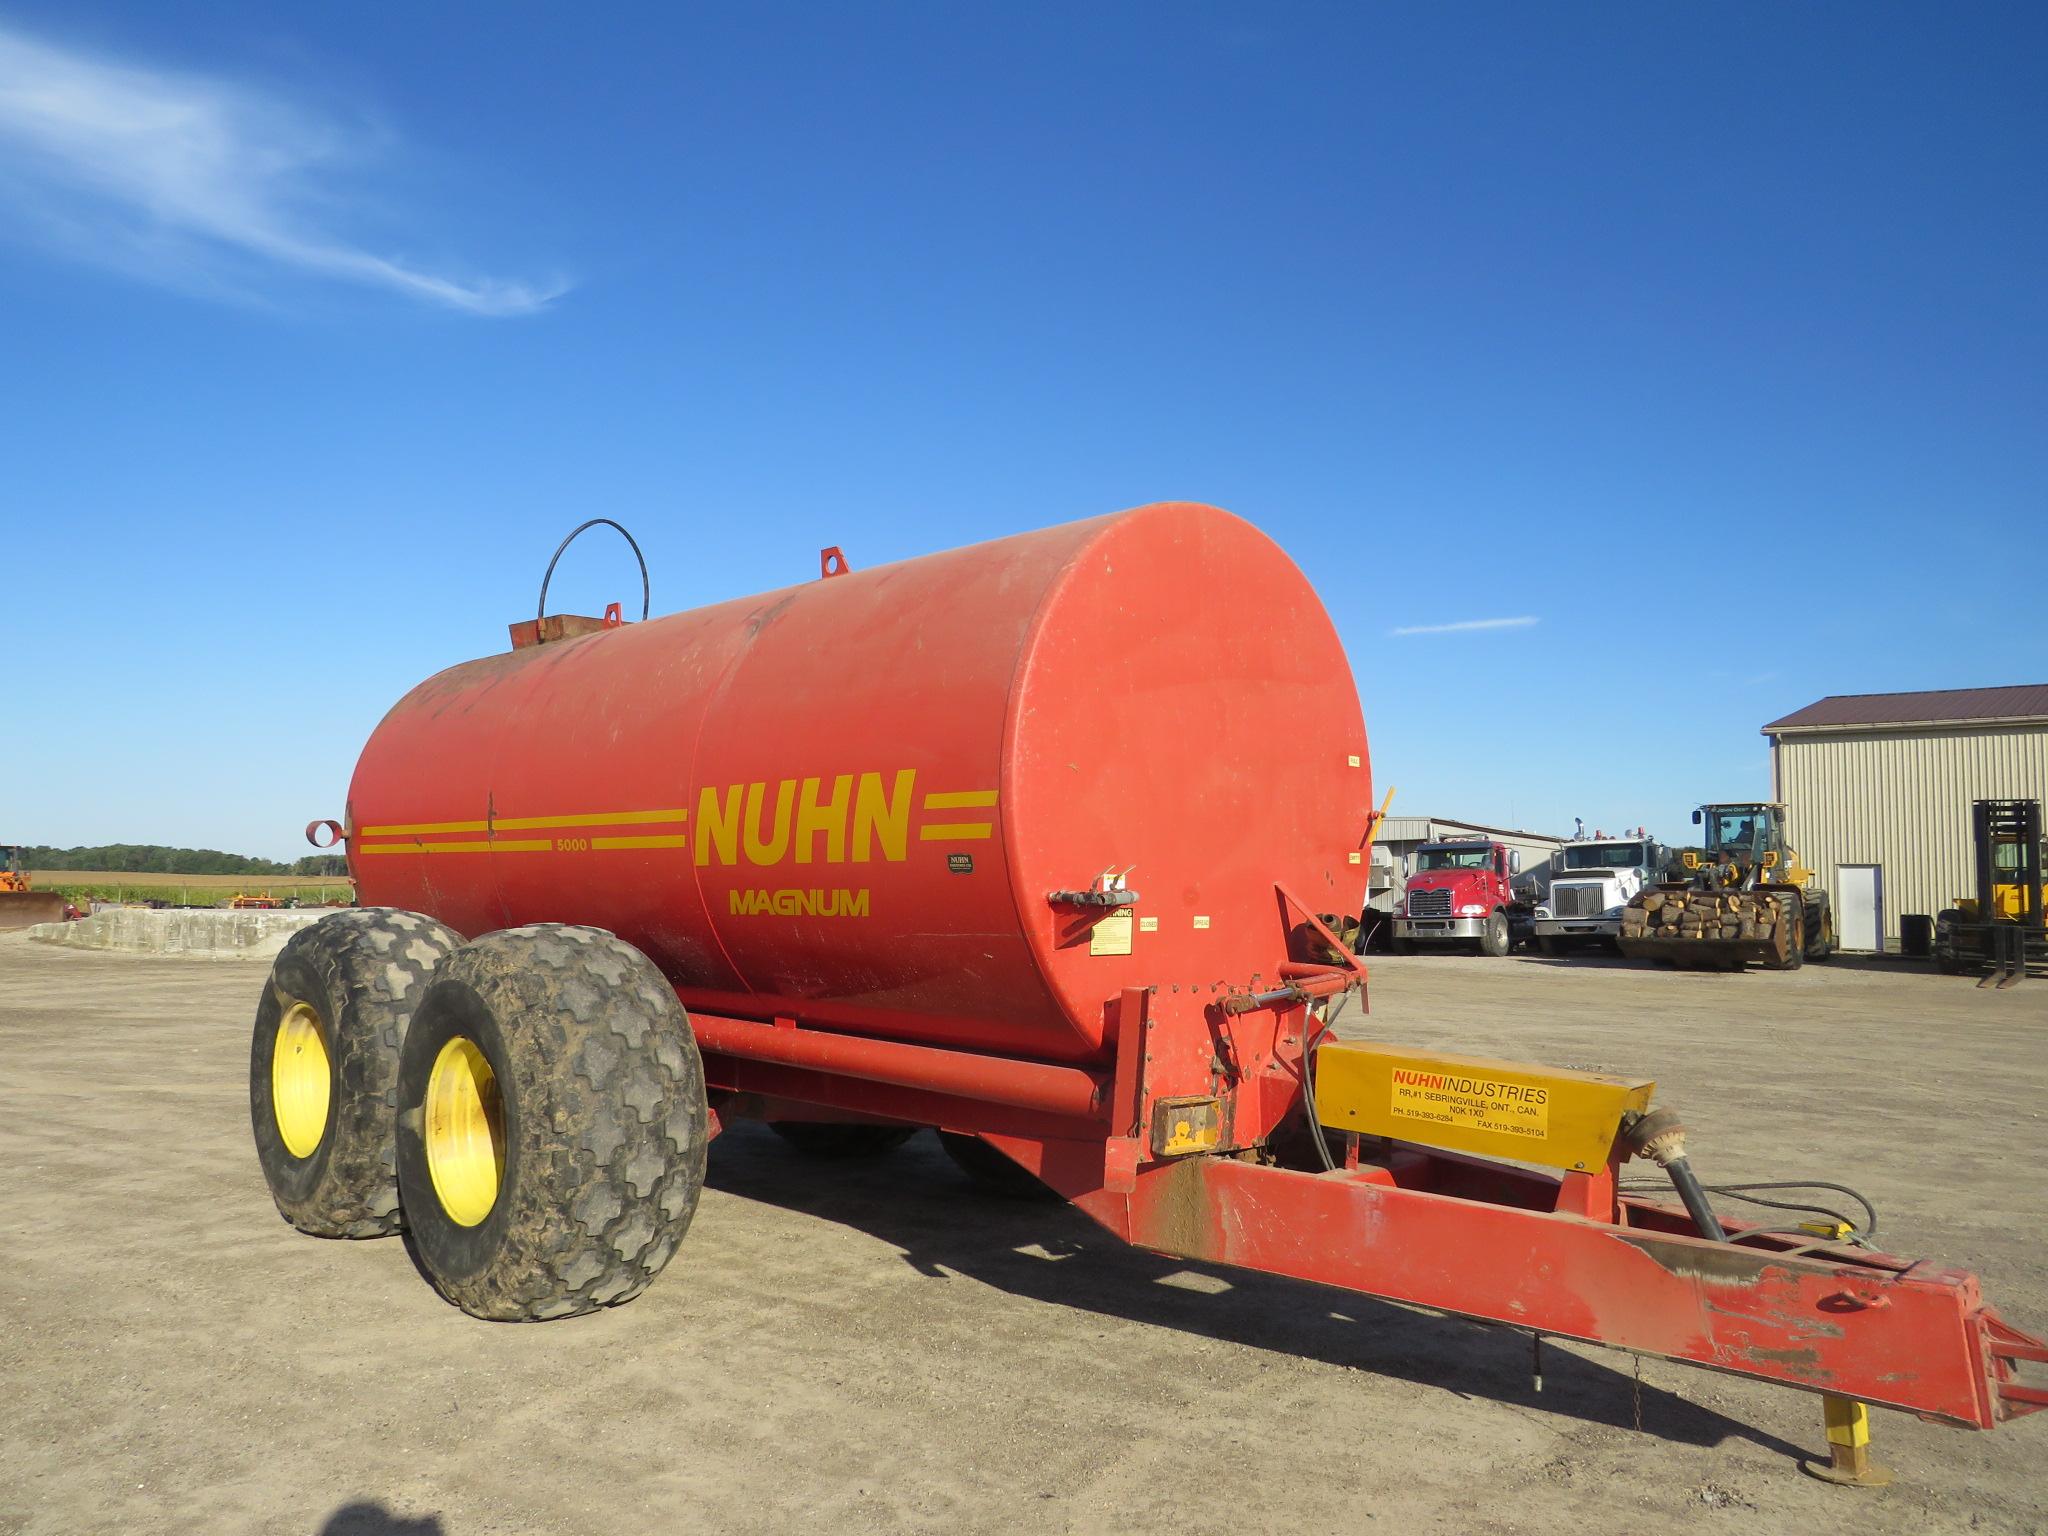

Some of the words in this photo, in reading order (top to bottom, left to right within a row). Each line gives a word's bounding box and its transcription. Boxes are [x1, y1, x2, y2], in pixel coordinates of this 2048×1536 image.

[695, 768, 917, 866] NUHN
[557, 838, 587, 852] 5000
[950, 856, 969, 864] NUHN
[729, 889, 870, 917] MAGNUM
[1425, 1092, 1488, 1110] SEBRINGVILLE,
[1517, 1106, 1539, 1117] CAN.
[1393, 1107, 1404, 1115] PH.
[1407, 1109, 1453, 1122] 519-393-6284
[1477, 1120, 1493, 1129] FAX
[1494, 1123, 1545, 1137] 519-393-5104
